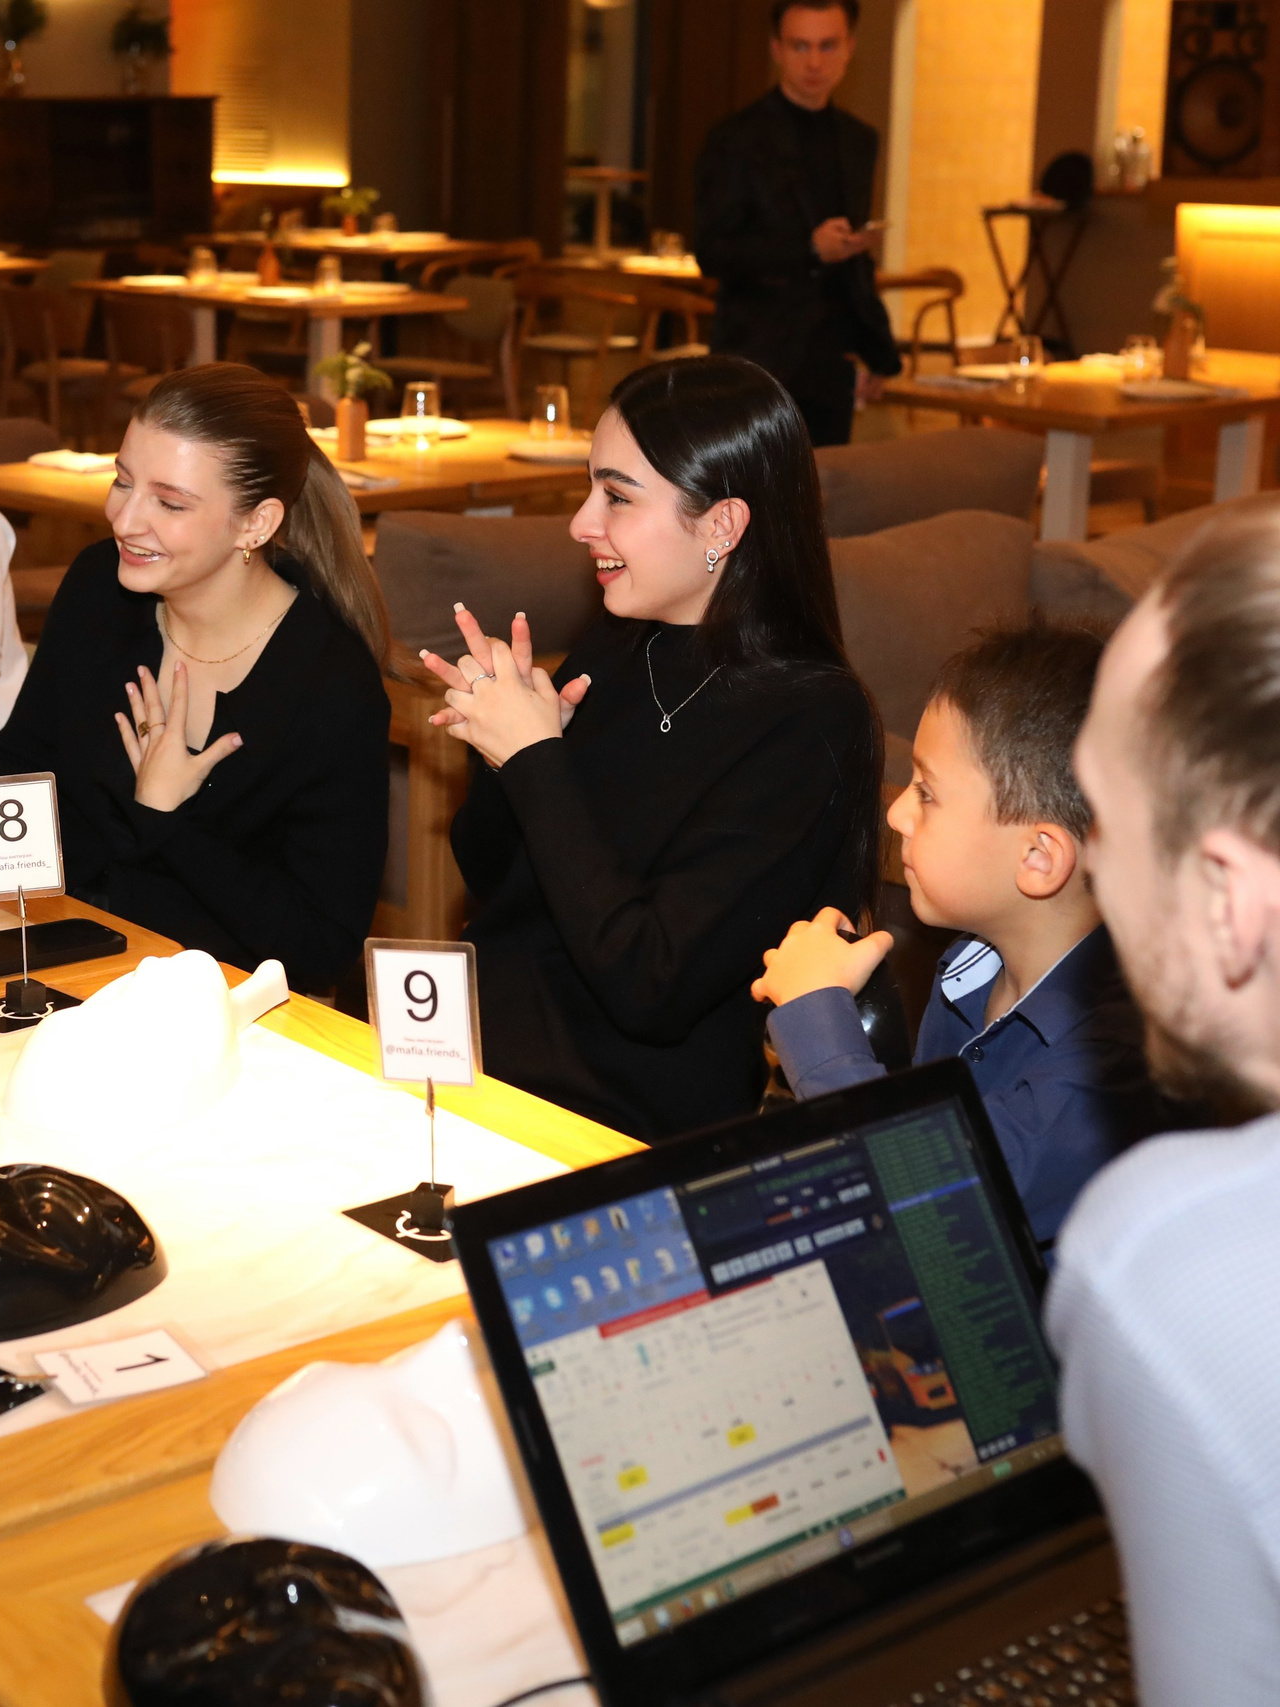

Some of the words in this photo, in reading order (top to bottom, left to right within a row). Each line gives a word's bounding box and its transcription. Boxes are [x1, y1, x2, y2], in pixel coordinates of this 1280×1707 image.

[404, 969, 439, 1022] 9
[385, 1044, 467, 1061] @mafia.friends_
[115, 1353, 170, 1372] 1
